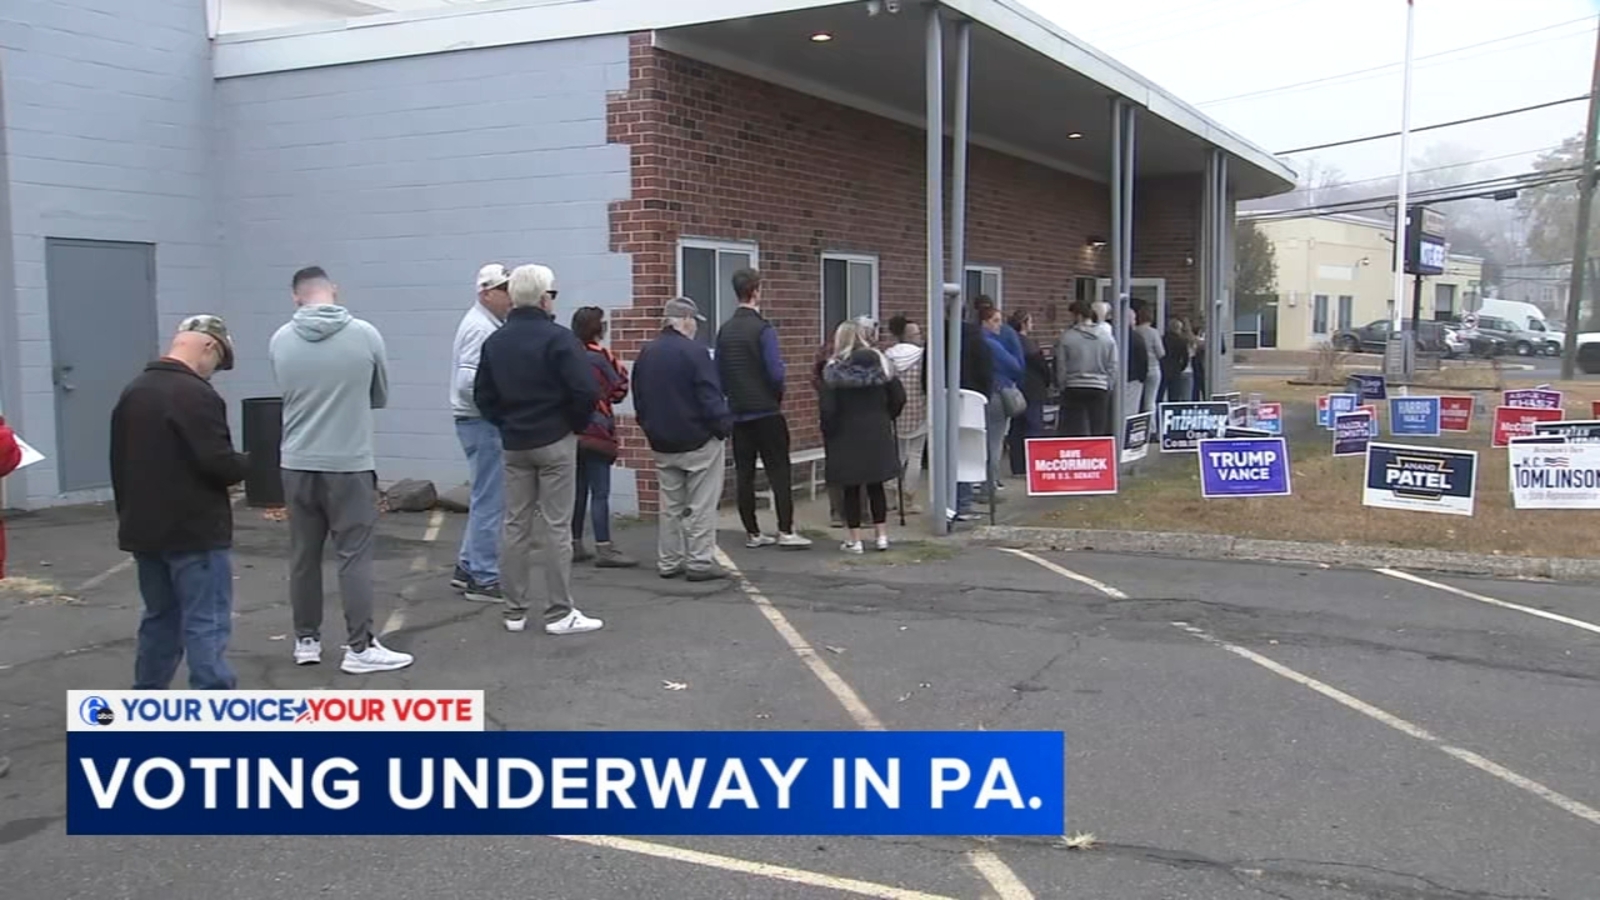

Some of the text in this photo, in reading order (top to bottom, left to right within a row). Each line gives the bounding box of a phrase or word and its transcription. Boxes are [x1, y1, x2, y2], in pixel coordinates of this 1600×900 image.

[1059, 449, 1082, 458] DAVE
[1208, 450, 1277, 468] TRUMP
[1034, 458, 1108, 471] McCORMICK
[1403, 462, 1437, 471] ANAND
[1042, 472, 1056, 480] FOR
[1217, 467, 1271, 481] VANCE
[1385, 469, 1453, 489] PATEL
